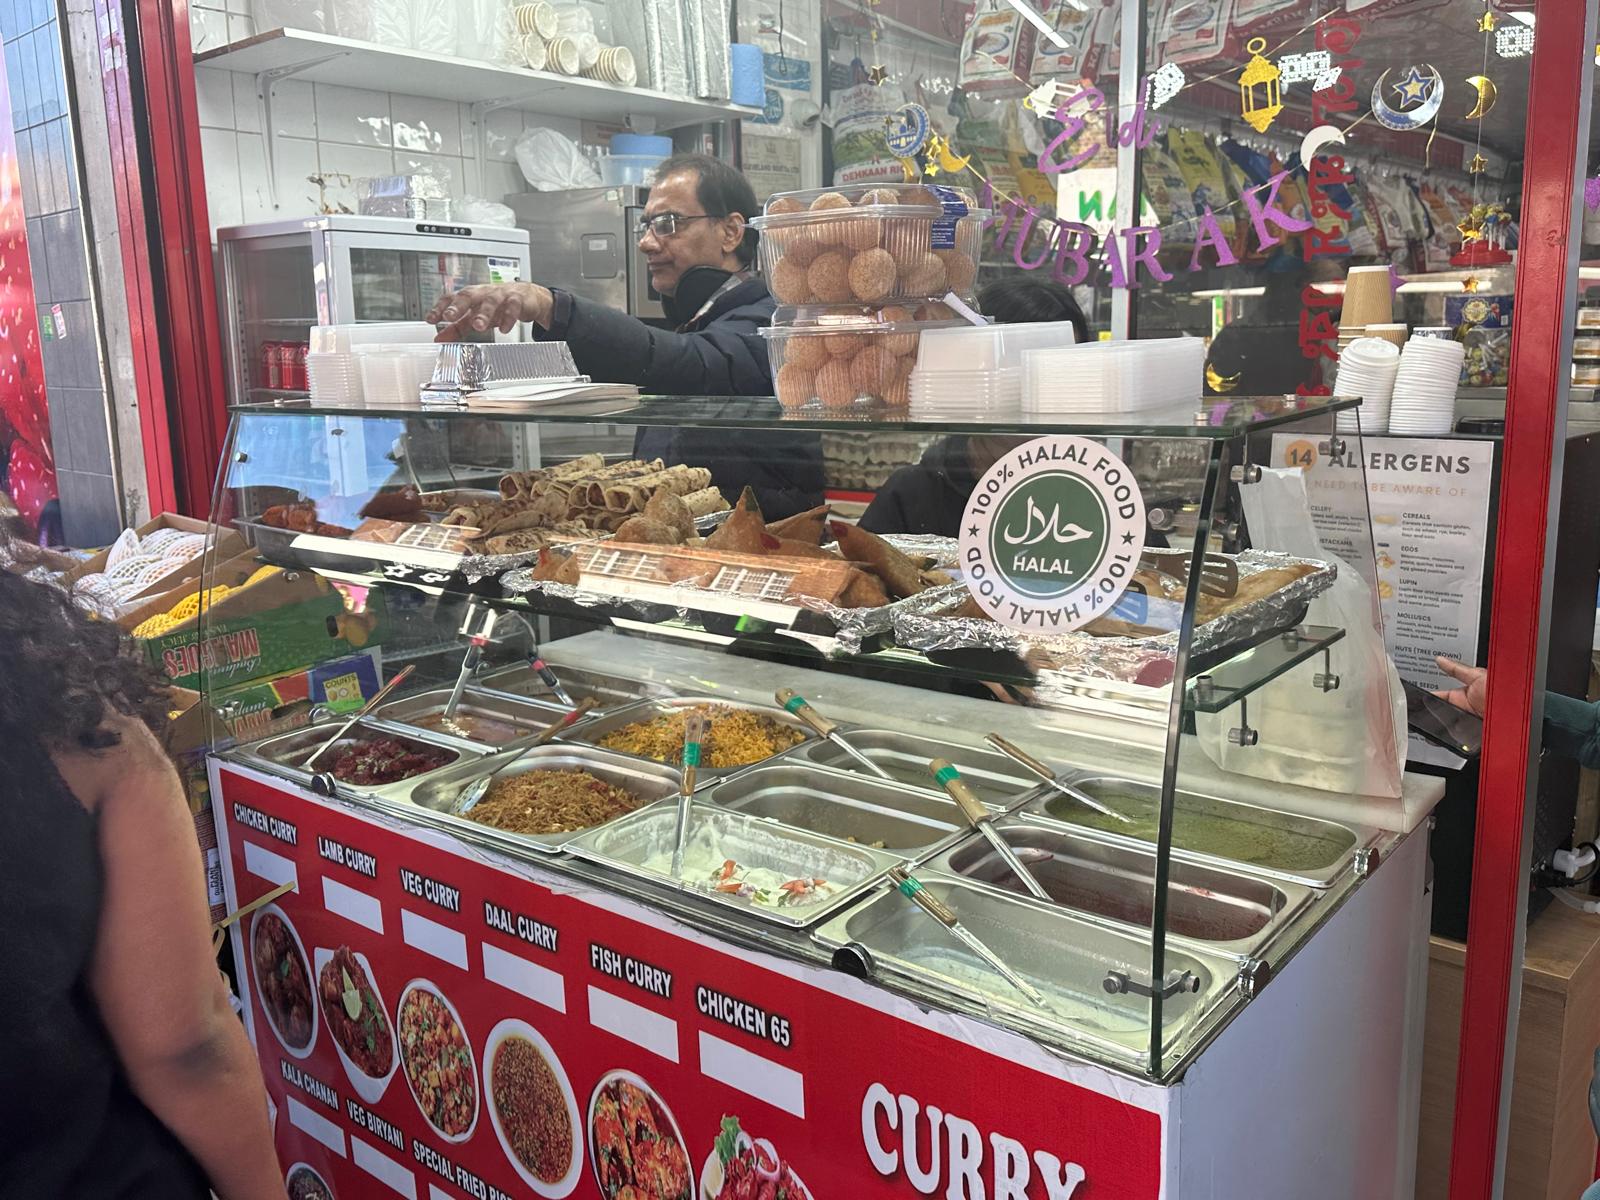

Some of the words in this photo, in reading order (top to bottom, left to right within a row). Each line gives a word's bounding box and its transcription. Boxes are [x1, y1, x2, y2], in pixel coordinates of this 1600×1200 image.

[1038, 75, 1163, 174] Eid
[842, 166, 887, 182] DEHKAAN
[972, 464, 1014, 515] 100%
[1018, 444, 1088, 470] HALAL
[1092, 456, 1136, 520] FOOD
[1290, 448, 1313, 467] 14
[1328, 451, 1470, 474] ALERGENS
[1371, 483, 1387, 493] BE
[1392, 484, 1442, 496] AWARE
[1448, 488, 1468, 497] OF
[1004, 496, 1094, 545] حلال
[1402, 512, 1431, 520] CEREALS
[967, 547, 1005, 609] FOOD
[1013, 556, 1073, 575] HALAL
[1084, 554, 1132, 610] 100%
[1399, 578, 1418, 586] LUPIN
[1010, 602, 1080, 627] HALAL
[1397, 612, 1432, 622] MOLLUSCS
[325, 673, 357, 689] COUNTS
[1420, 682, 1439, 690] SEEDS
[234, 803, 268, 833] CHICKEN
[270, 818, 296, 845] CURRY
[318, 836, 344, 864] LAMB
[346, 848, 376, 877] CURRY
[400, 868, 422, 896] VEG
[424, 878, 460, 912] CURRY
[485, 902, 515, 935] DAAL
[518, 916, 557, 952] CURRY
[591, 944, 622, 978] FISH
[626, 958, 672, 998] CURRY
[698, 986, 766, 1037] CHICKEN
[770, 1015, 790, 1047] 65
[281, 1060, 303, 1089] KALA
[304, 1074, 339, 1110] CHANAN
[346, 1100, 366, 1127] VEG
[366, 1111, 404, 1152] BIRYANI
[413, 1140, 455, 1182] SPECIAL
[456, 1166, 487, 1200] FRIED
